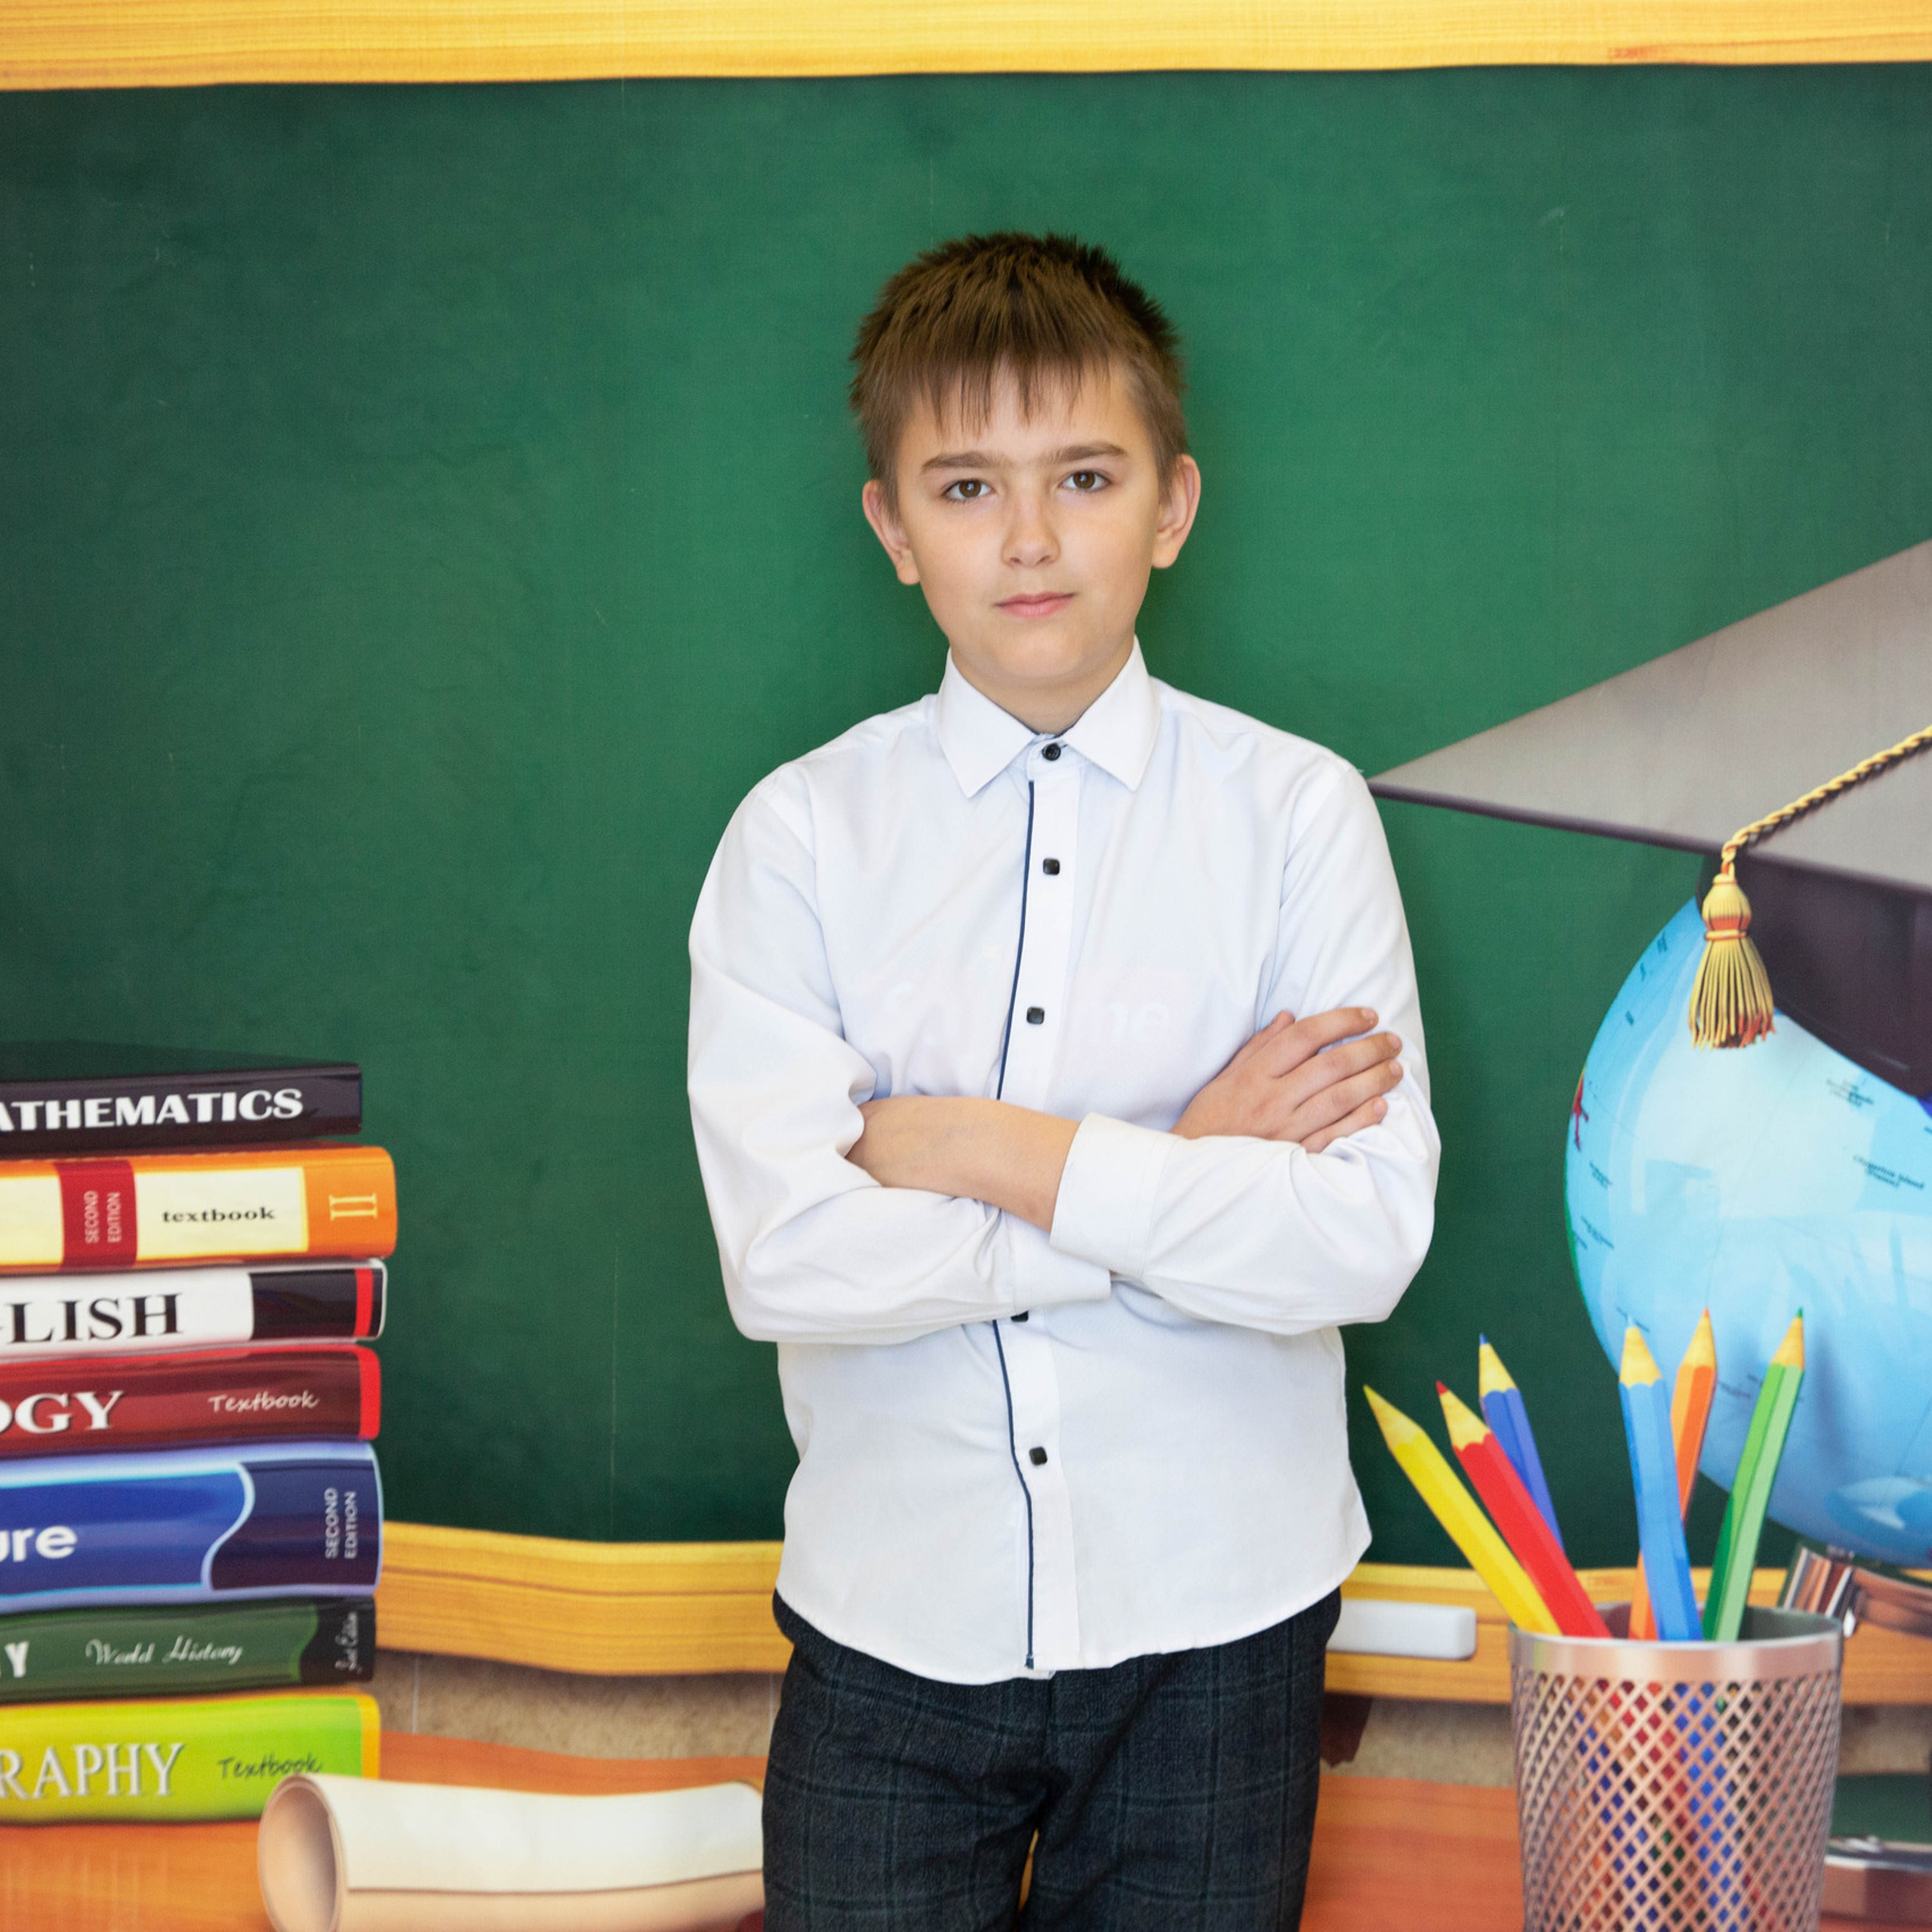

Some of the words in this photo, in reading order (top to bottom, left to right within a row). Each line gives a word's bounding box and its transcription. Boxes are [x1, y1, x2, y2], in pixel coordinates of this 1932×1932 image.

[83, 1190, 100, 1244] SECOND
[106, 1192, 122, 1243] EDITION
[162, 1207, 275, 1223] textbook
[0, 1293, 183, 1344] LISH
[0, 1390, 124, 1434] GY
[208, 1389, 320, 1414] Textbook
[324, 1487, 340, 1559] SECOND
[343, 1491, 358, 1559] EDITION
[0, 1742, 183, 1801] RAPHY
[217, 1752, 323, 1780] Textbook
